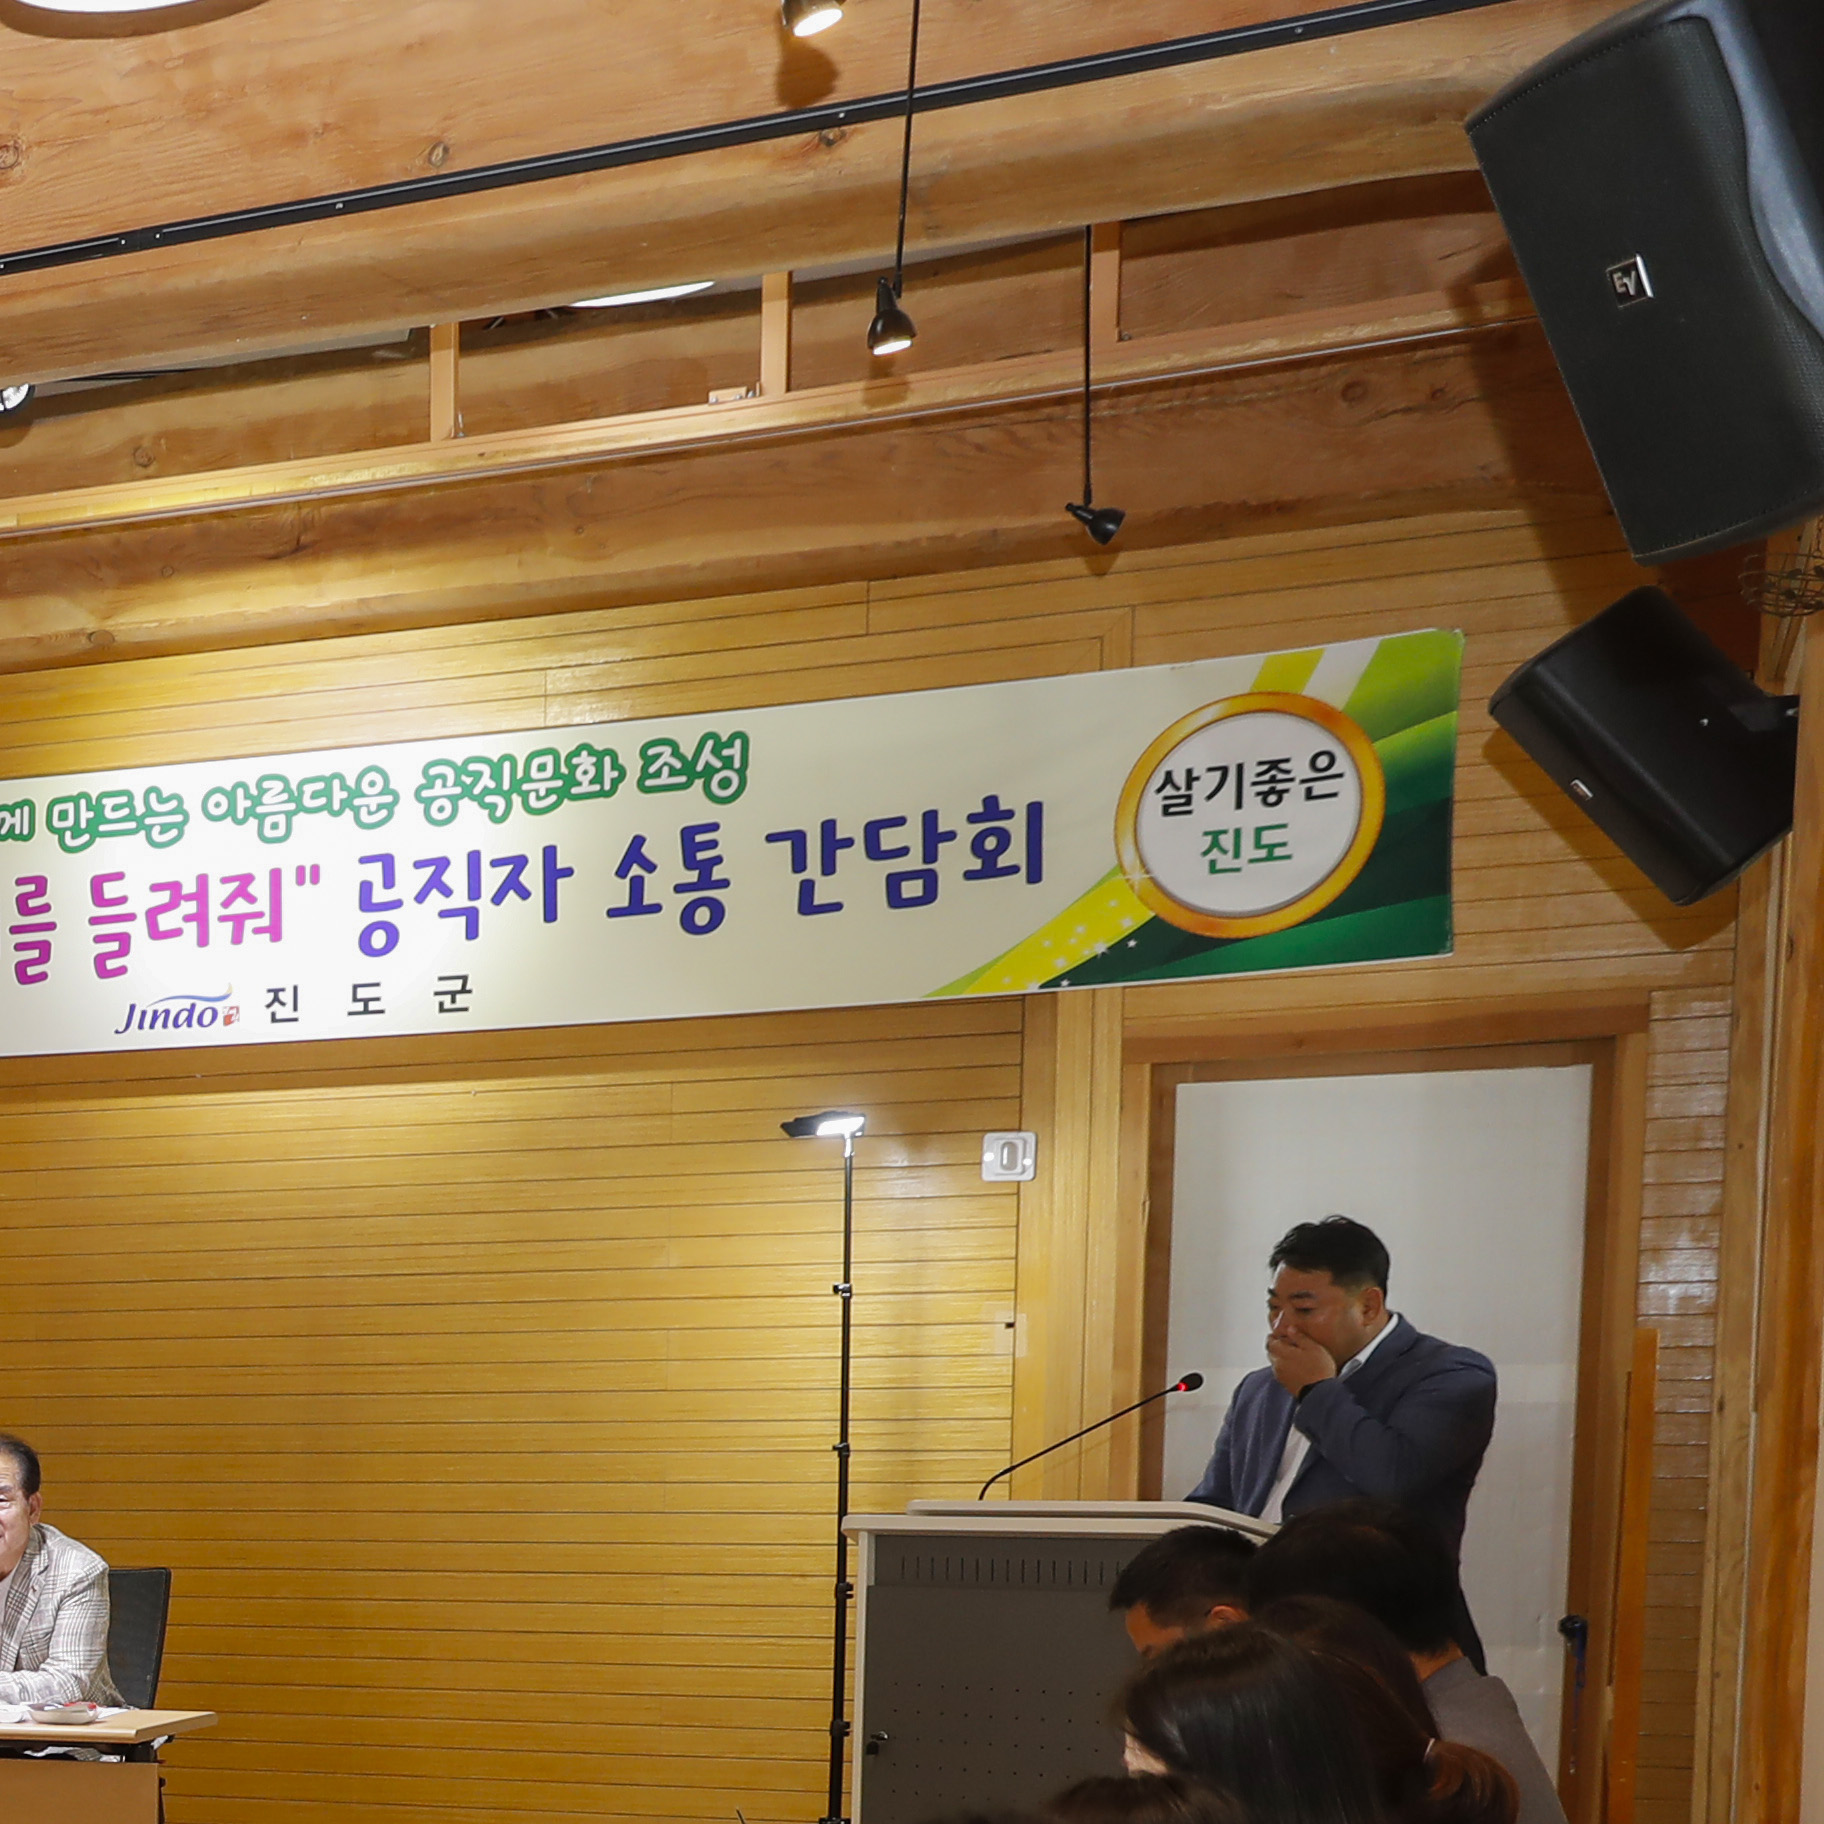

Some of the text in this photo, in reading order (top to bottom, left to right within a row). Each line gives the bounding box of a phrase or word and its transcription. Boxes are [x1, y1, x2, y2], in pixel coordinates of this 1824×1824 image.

[46, 786, 189, 854] 만드는
[202, 766, 399, 844] 아름다운
[414, 742, 626, 827] 공직문화
[637, 730, 750, 805] 조성
[1155, 750, 1345, 817] 살기좋은
[88, 863, 320, 980] 들려줘"
[357, 844, 575, 958] 공직자
[606, 821, 731, 936] 소통
[764, 794, 1044, 916] 간담회
[1201, 823, 1293, 875] 진도
